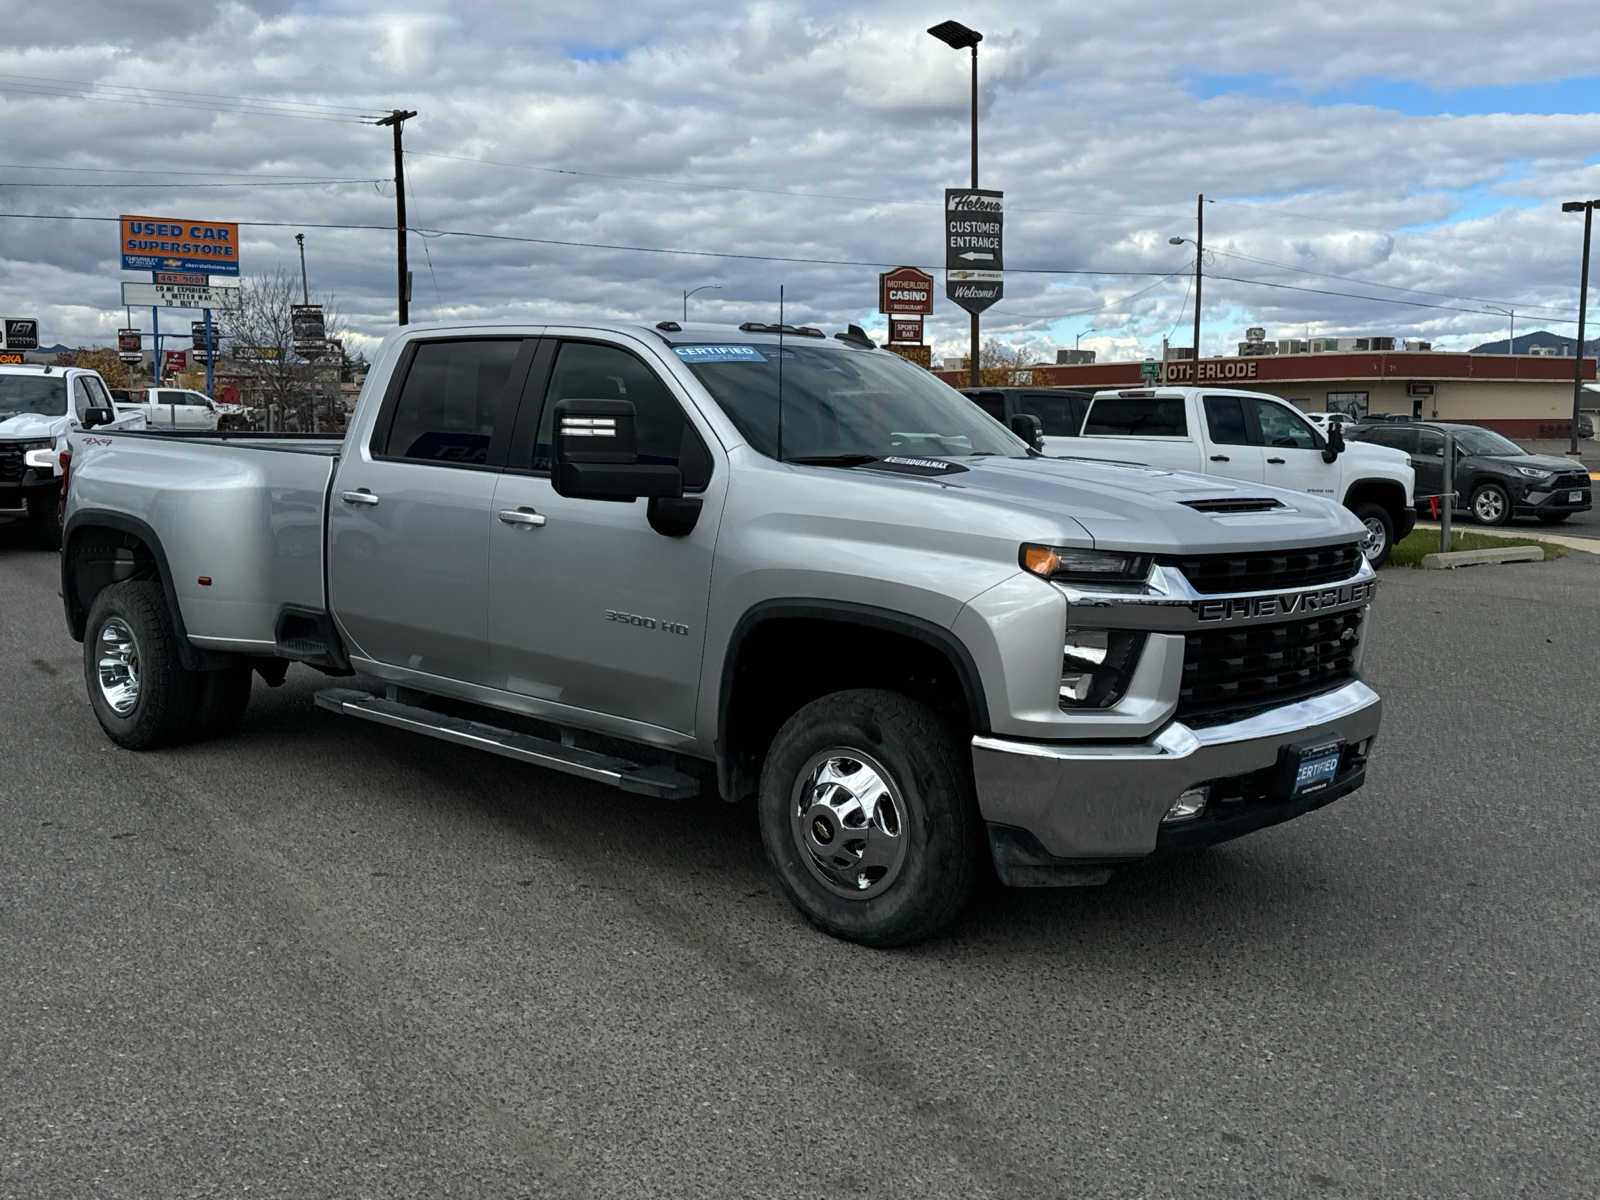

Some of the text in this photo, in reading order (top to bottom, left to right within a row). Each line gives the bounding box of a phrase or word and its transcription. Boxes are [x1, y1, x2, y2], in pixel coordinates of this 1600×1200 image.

[954, 195, 1003, 211] Helena
[129, 222, 229, 241] USED CAR
[950, 221, 1000, 235] CUSTOMER
[127, 239, 234, 256] SUPERSTORE
[950, 236, 1000, 249] ENTRANCE
[887, 280, 929, 290] MOTHERLODE
[954, 285, 999, 298] Welcome!
[889, 290, 927, 302] CASINO
[675, 346, 754, 356] CERTIFIED
[1198, 583, 1377, 623] CHEVROLET
[605, 609, 689, 636] 3500 HD
[1297, 758, 1338, 781] CERTIFIED
